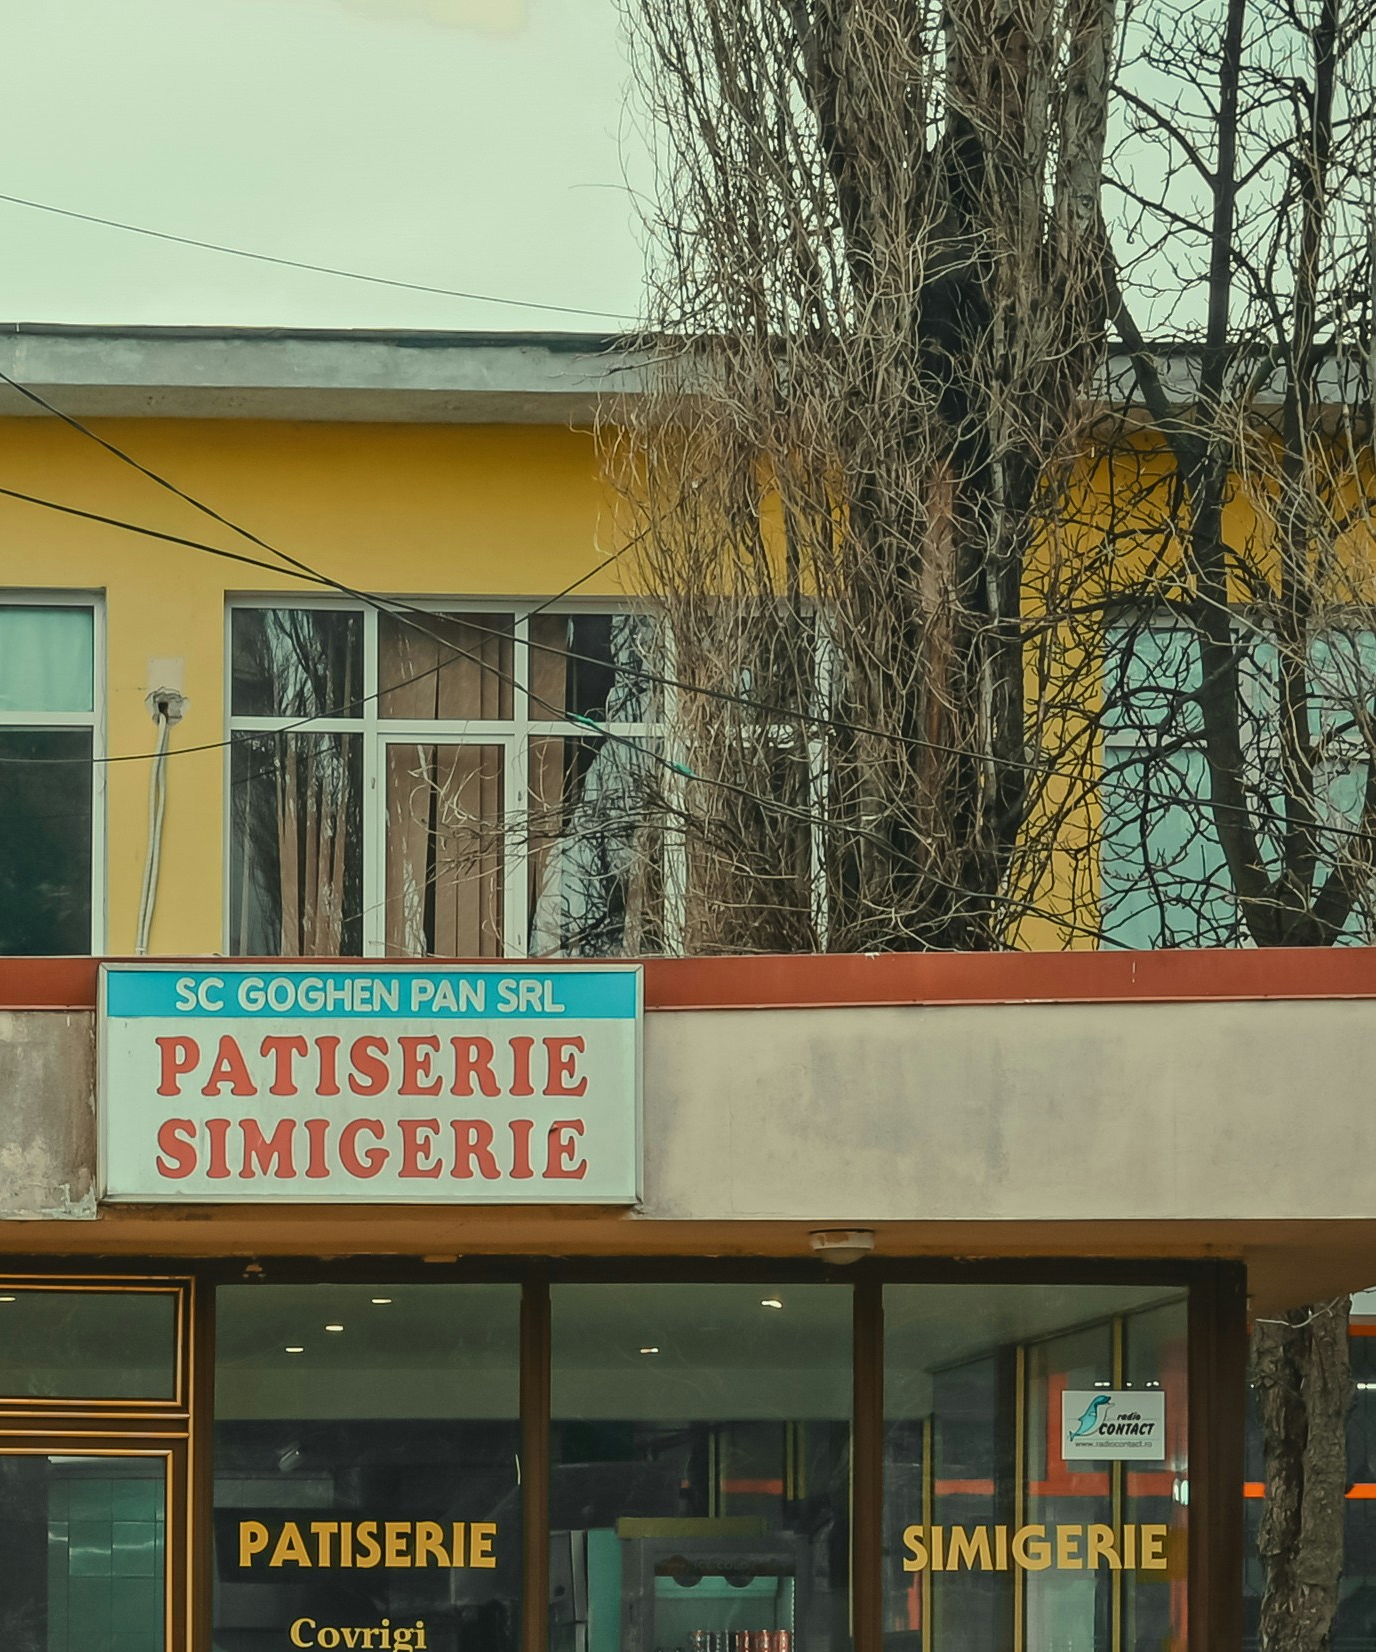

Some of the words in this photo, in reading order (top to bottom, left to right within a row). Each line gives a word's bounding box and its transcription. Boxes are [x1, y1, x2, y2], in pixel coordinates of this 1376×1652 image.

[174, 977, 225, 1012] SC
[238, 976, 399, 1013] GOGHEN
[410, 978, 486, 1013] PAN
[497, 978, 566, 1013] SRL
[154, 1034, 589, 1098] PATISERIE
[154, 1117, 589, 1181] SIMIGERIE
[1099, 1422, 1155, 1436] CONTACT
[1117, 1411, 1142, 1420] radio
[238, 1521, 497, 1569] PATISERIE
[902, 1523, 1168, 1572] SIMIGERIE
